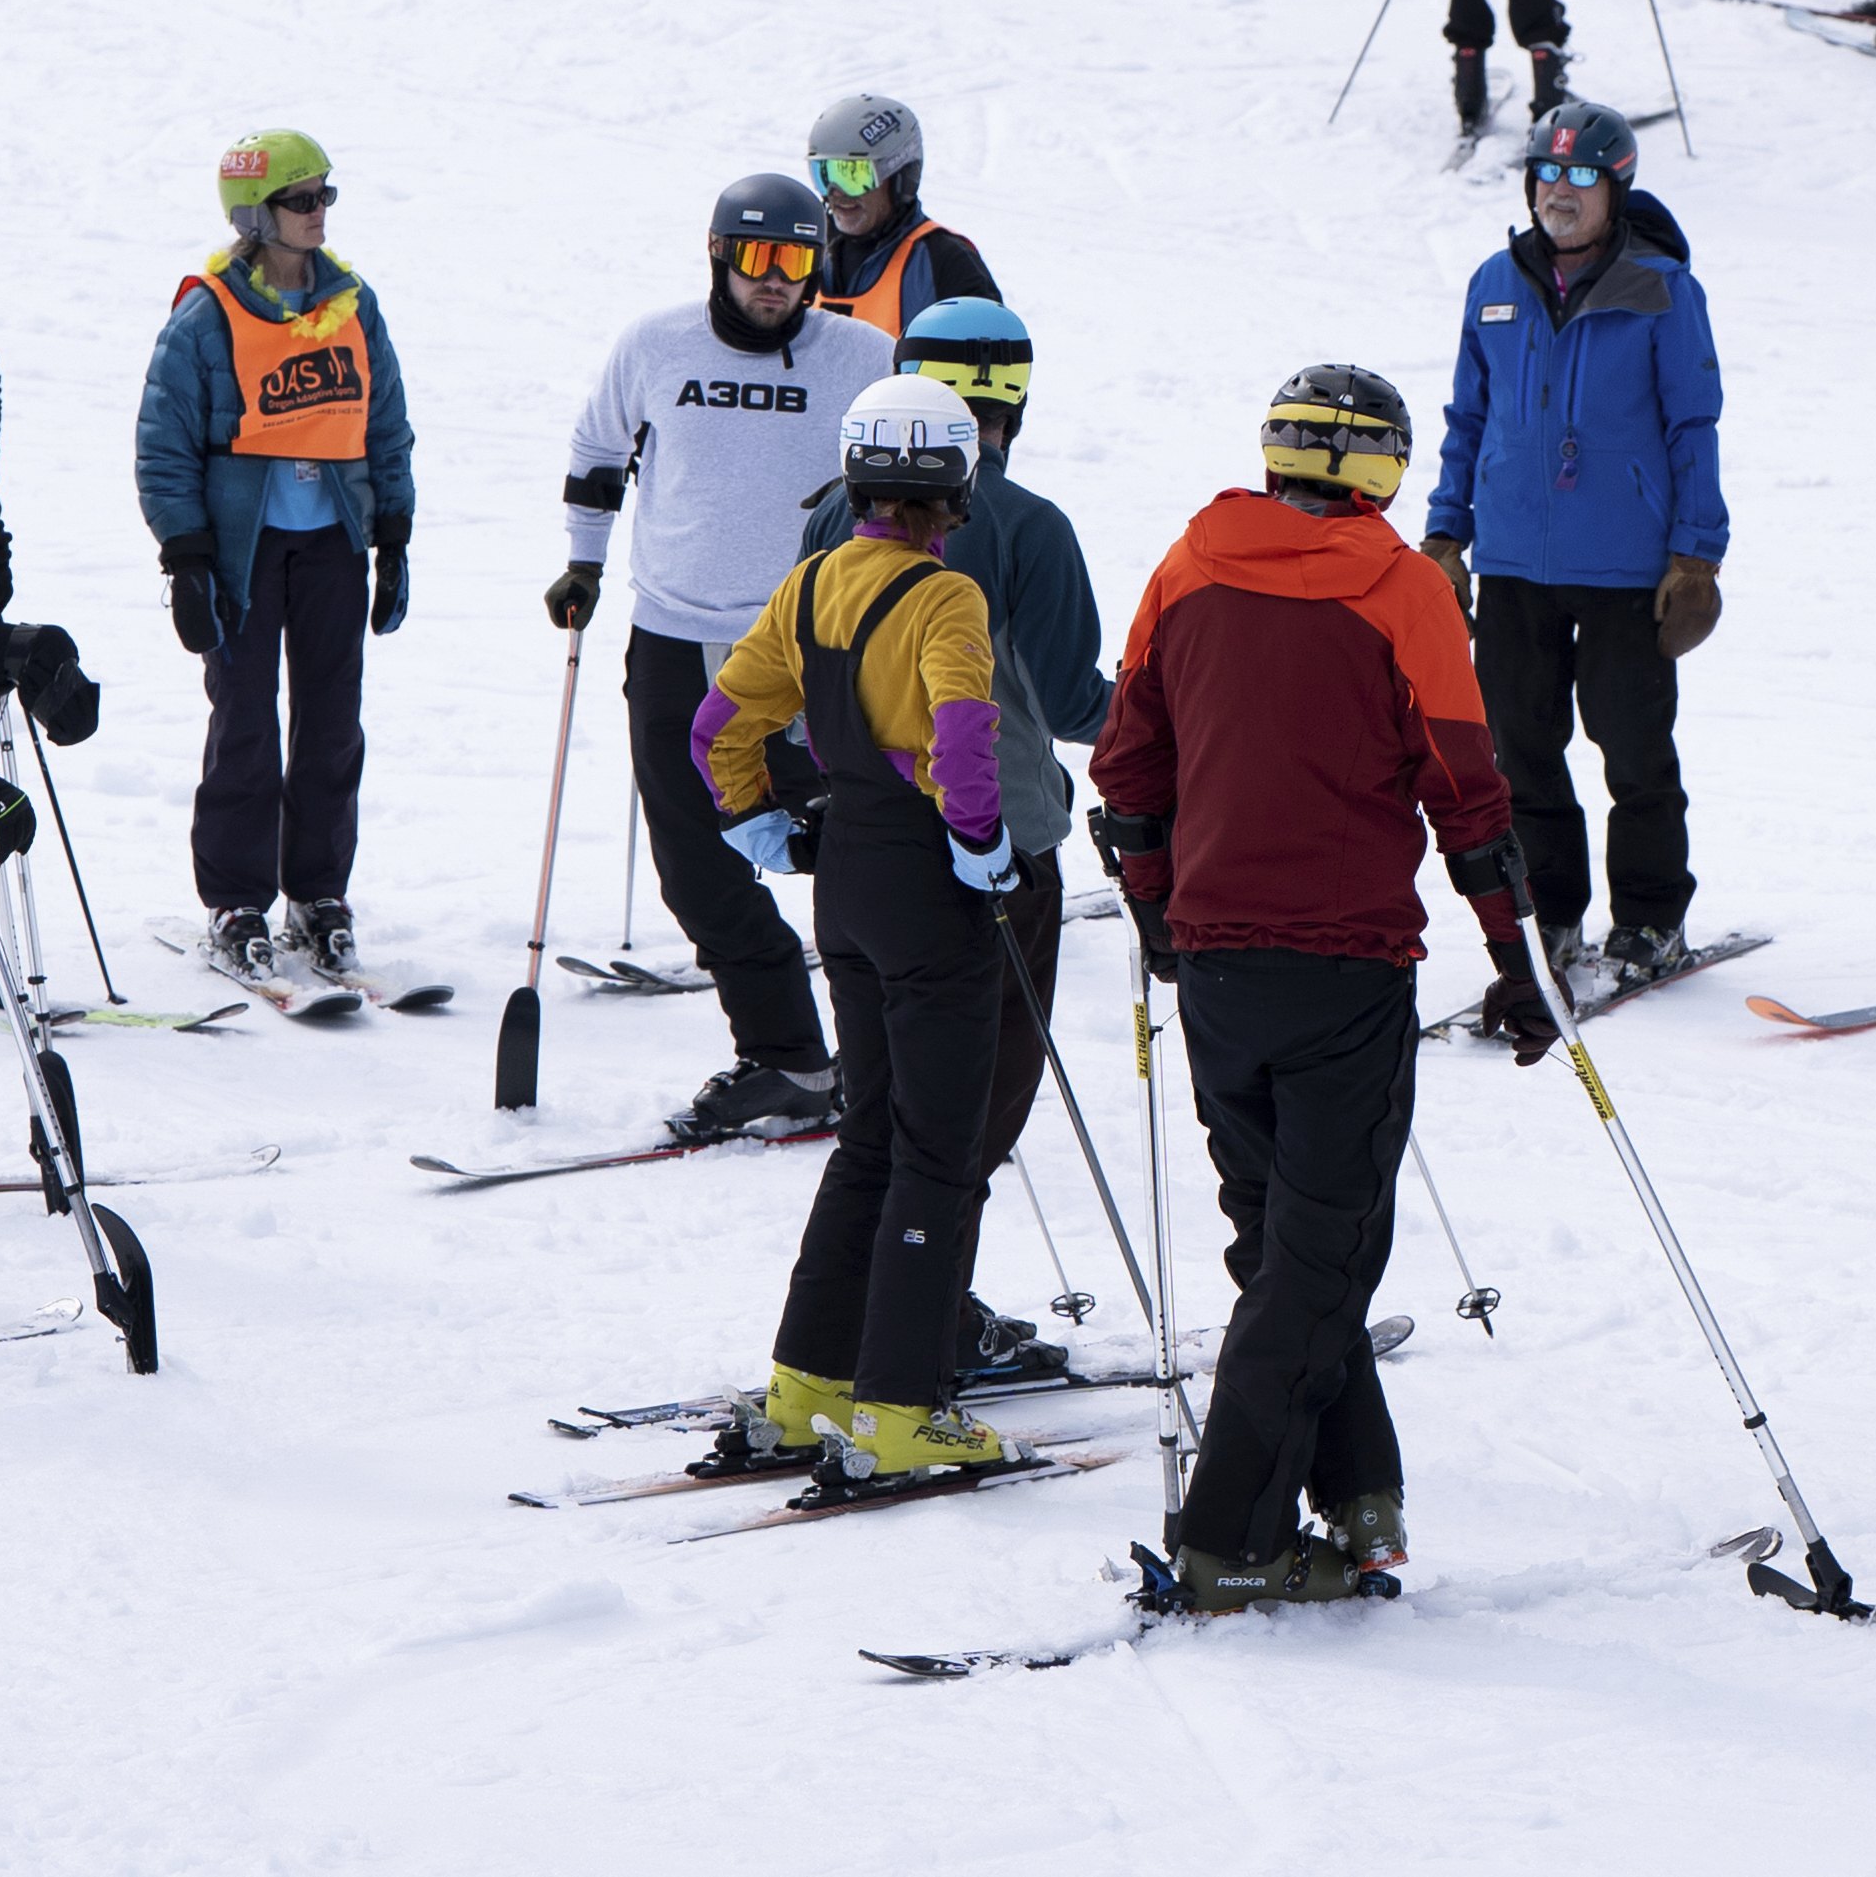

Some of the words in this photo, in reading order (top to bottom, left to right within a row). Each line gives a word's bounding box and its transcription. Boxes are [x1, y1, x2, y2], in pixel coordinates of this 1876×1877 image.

[863, 118, 887, 141] OAS
[267, 360, 321, 397] OAS
[268, 398, 295, 411] Oregon
[297, 388, 333, 404] Adaptive
[333, 386, 357, 398] Sports
[1135, 1004, 1149, 1078] SUPERLITE
[912, 1424, 988, 1451] FISCHER
[1217, 1577, 1267, 1587] ROXA
